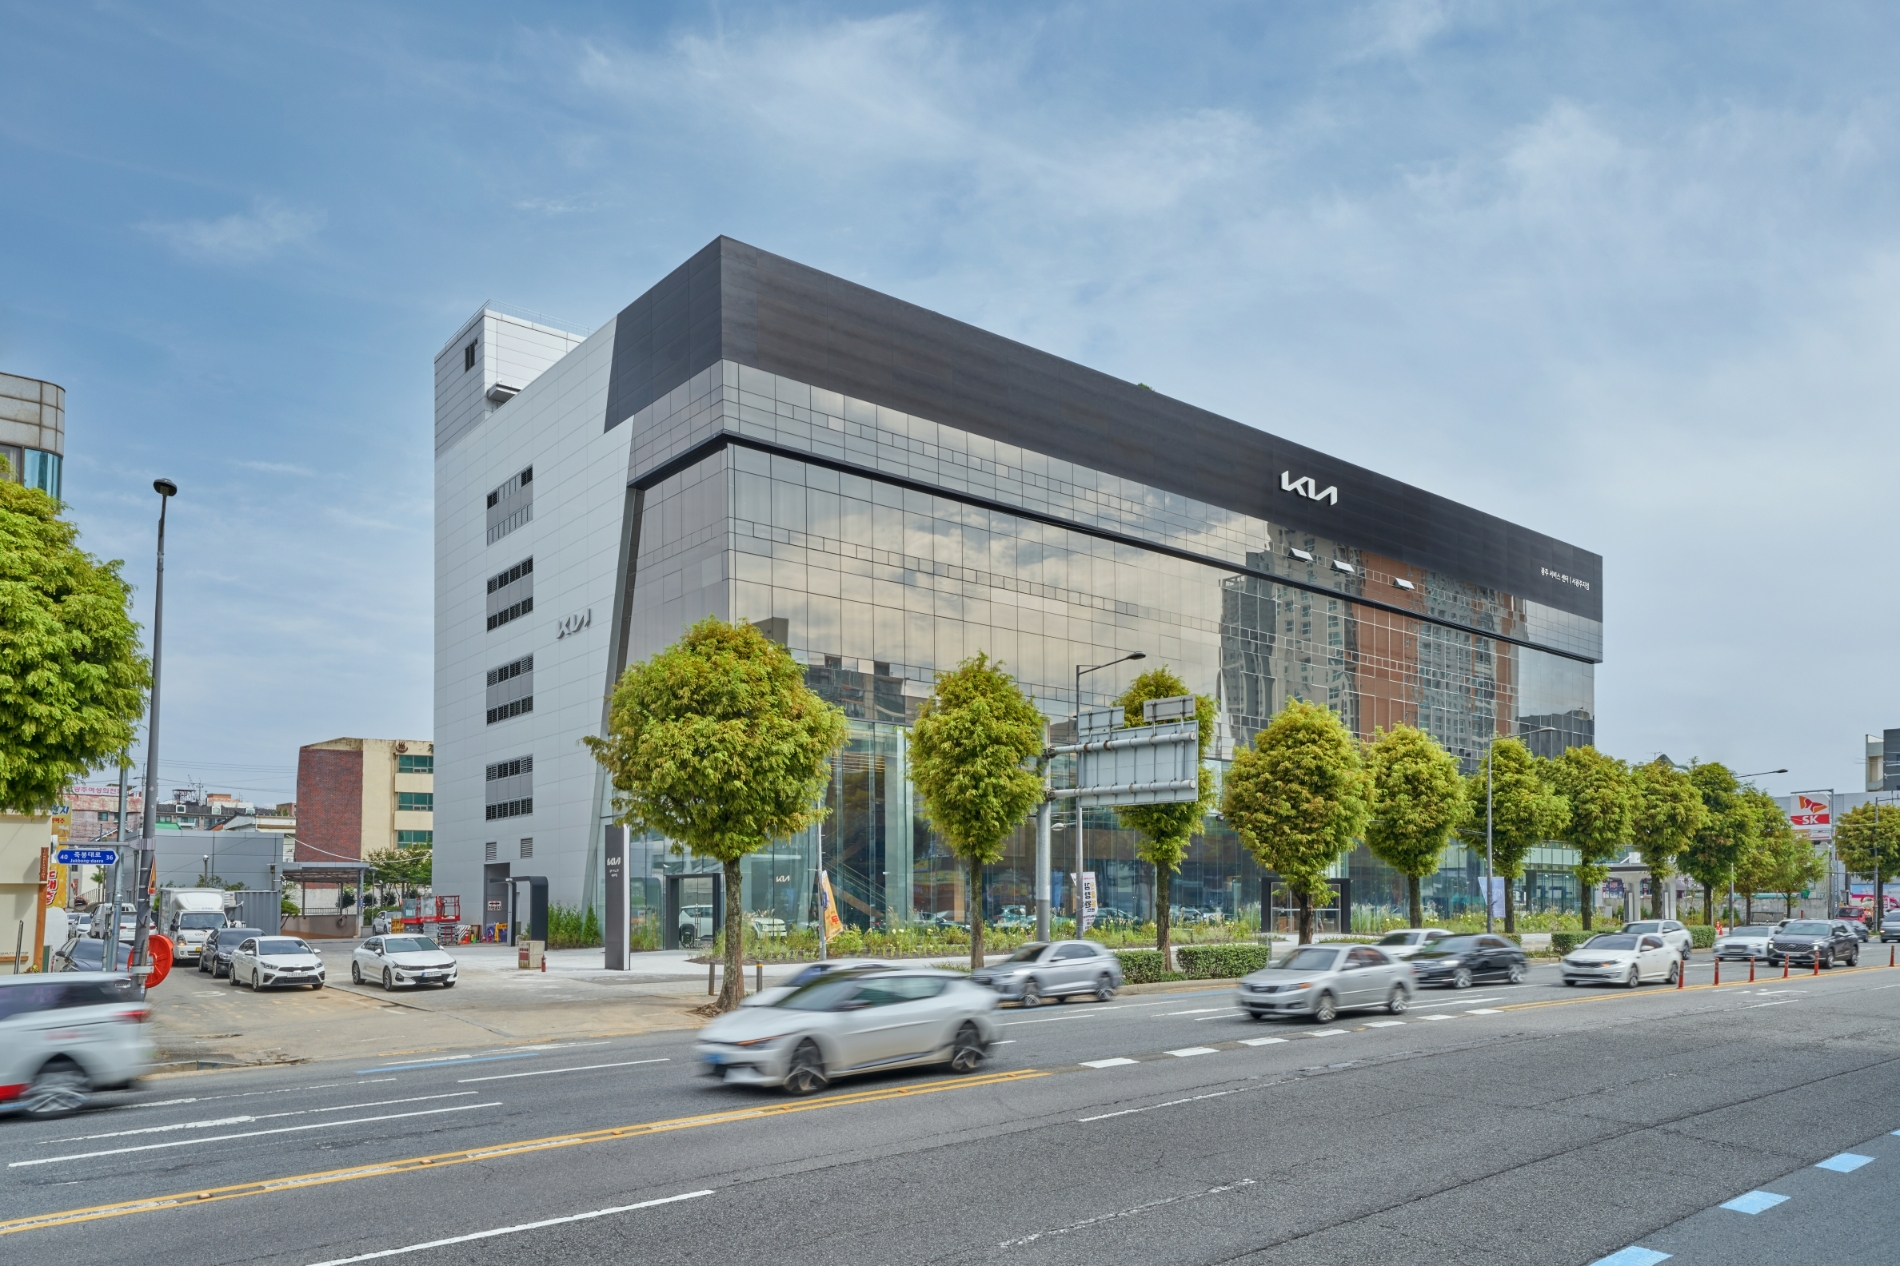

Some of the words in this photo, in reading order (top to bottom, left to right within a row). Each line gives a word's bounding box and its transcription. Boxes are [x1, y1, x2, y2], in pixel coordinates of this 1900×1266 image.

[1281, 470, 1338, 506] KIA
[74, 786, 120, 794] 광주여성의전
[1802, 815, 1819, 824] SK
[73, 851, 102, 859] 죽봉대로
